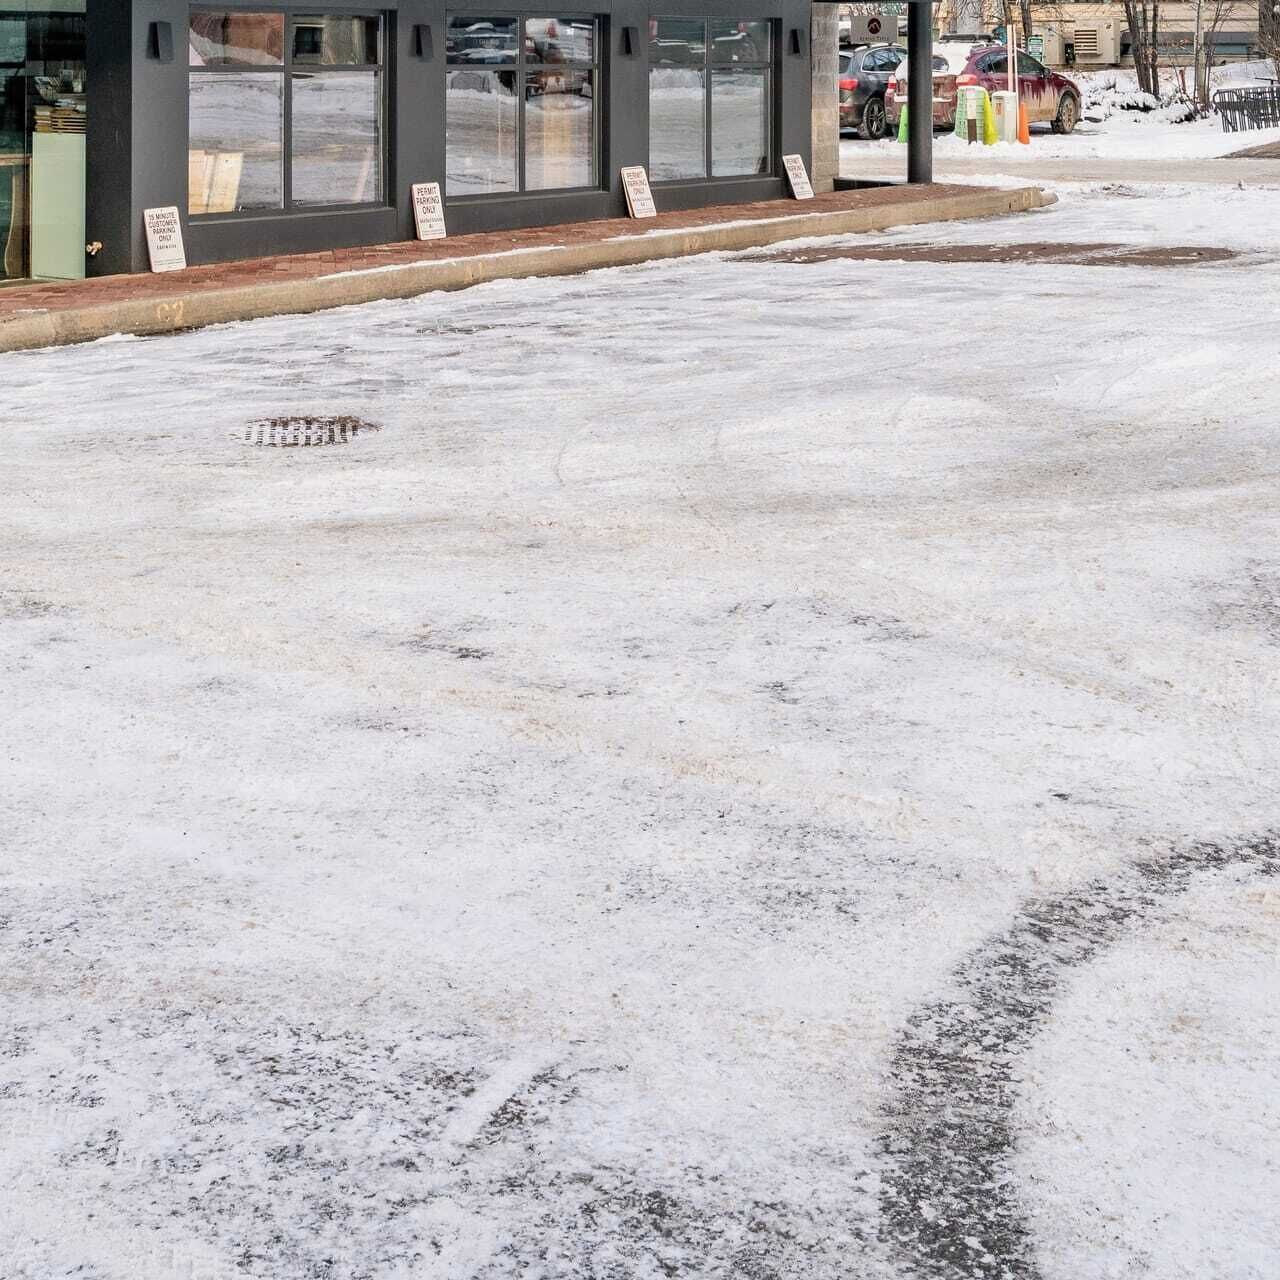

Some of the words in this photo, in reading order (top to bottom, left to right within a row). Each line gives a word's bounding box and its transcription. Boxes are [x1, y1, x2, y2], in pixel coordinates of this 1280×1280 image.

[416, 186, 437, 196] PERMIT
[415, 195, 440, 205] PARKING
[422, 205, 437, 215] ONLY
[155, 211, 176, 220] MINUTE
[148, 219, 177, 228] CUSTOMER
[152, 226, 176, 235] PARKING
[158, 234, 173, 242] ONLY
